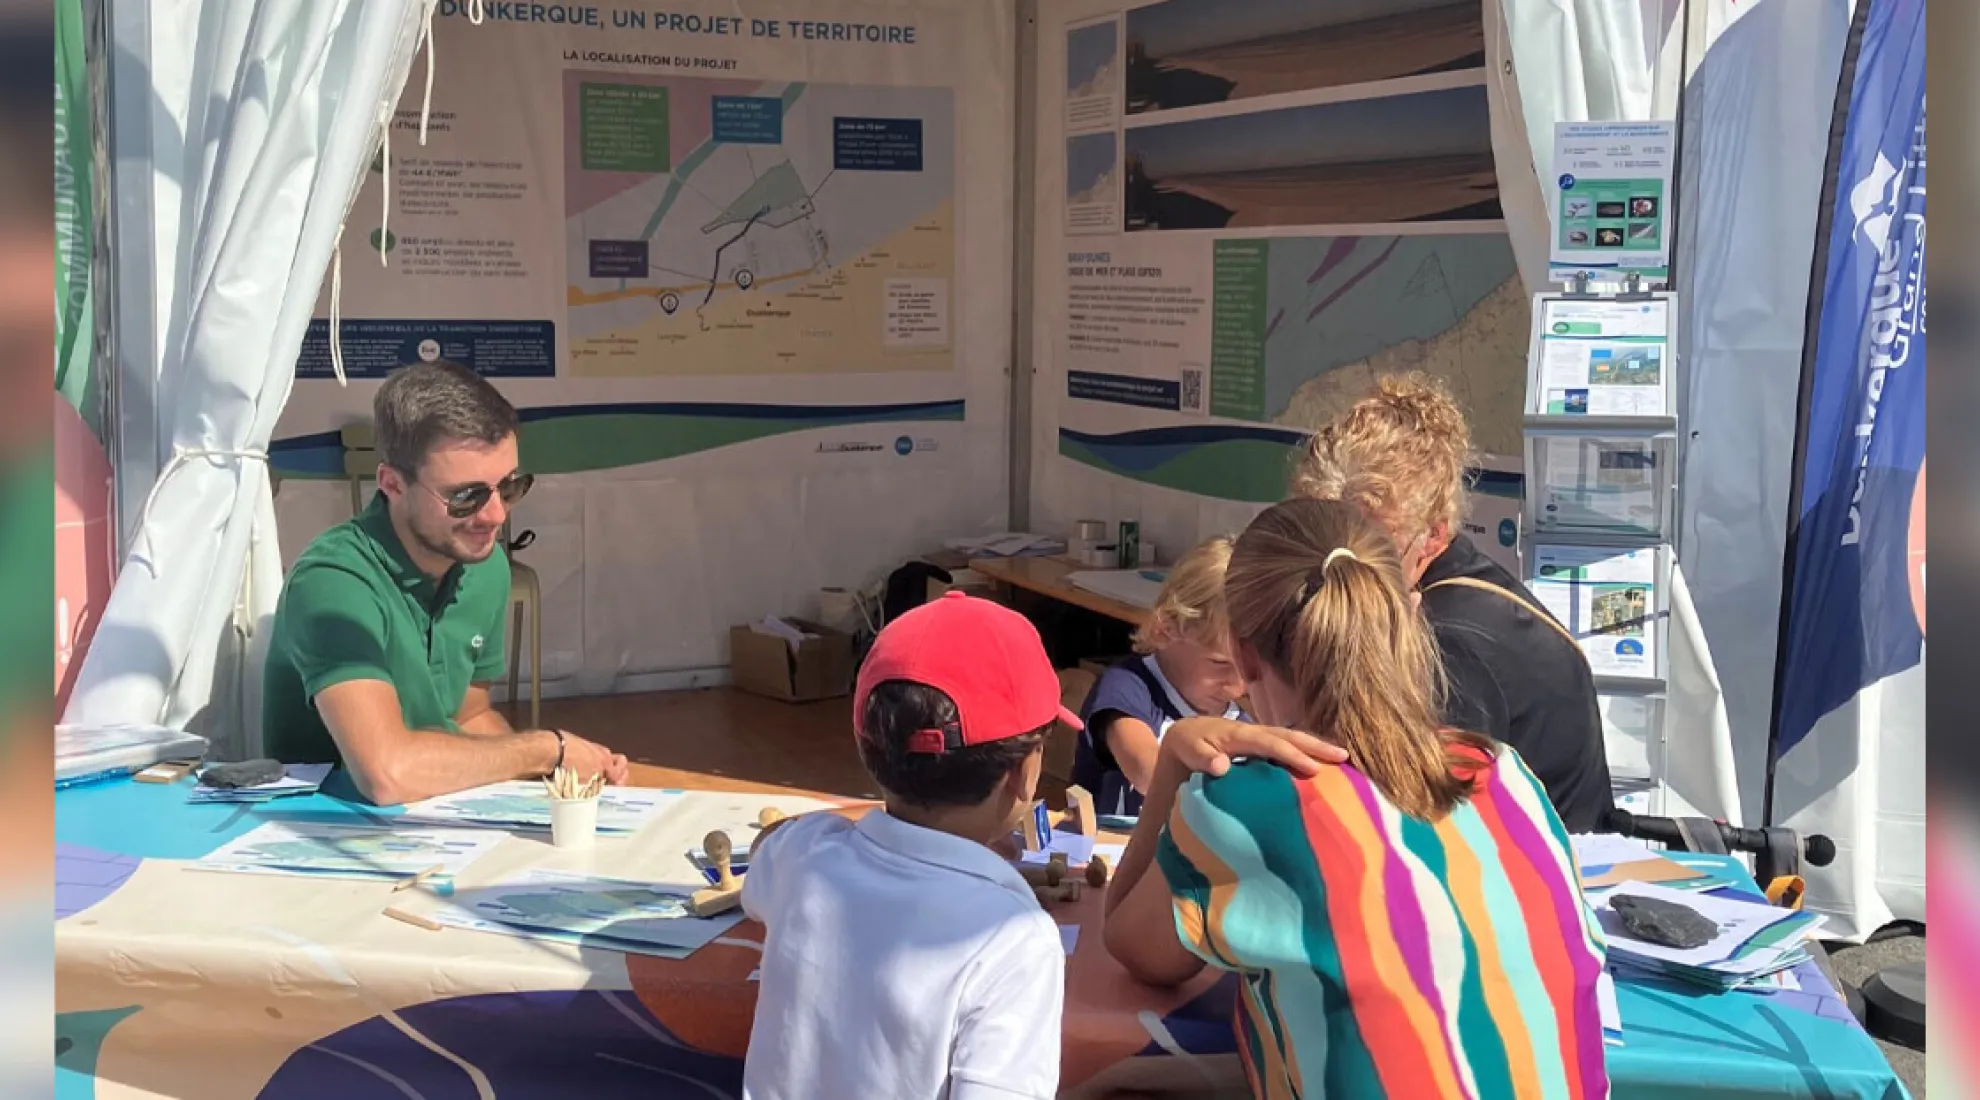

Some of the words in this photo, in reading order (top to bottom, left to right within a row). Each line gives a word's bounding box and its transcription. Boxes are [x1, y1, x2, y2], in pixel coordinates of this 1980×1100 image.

[612, 10, 647, 29] UN
[655, 13, 743, 35] PROJET
[751, 19, 781, 38] DE
[788, 21, 916, 44] TERRITOIRE
[563, 50, 579, 61] LA
[582, 51, 671, 66] LOCALISATION
[674, 56, 691, 68] DU
[693, 57, 737, 70] PROJET
